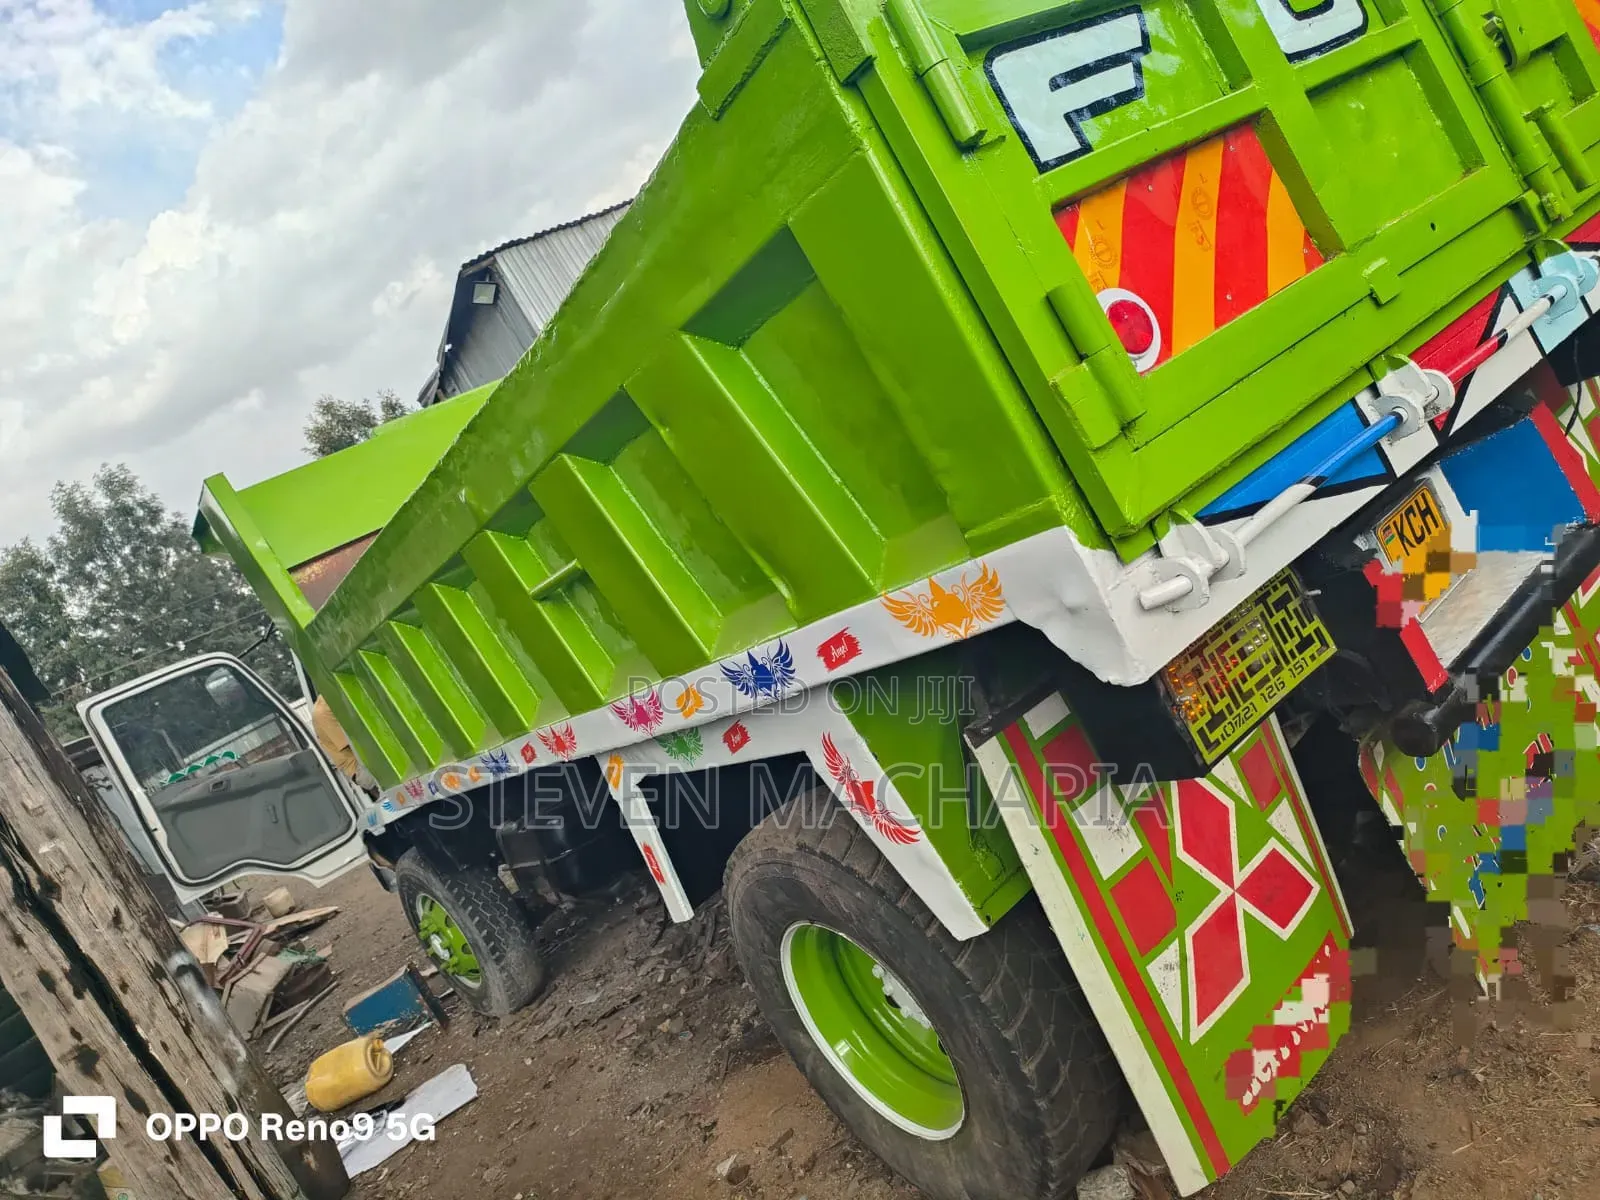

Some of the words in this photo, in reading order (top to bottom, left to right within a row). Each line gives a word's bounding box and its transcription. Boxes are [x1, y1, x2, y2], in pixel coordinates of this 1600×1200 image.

[1392, 492, 1439, 557] KCH
[1260, 676, 1287, 703] 126
[1288, 656, 1310, 680] 151
